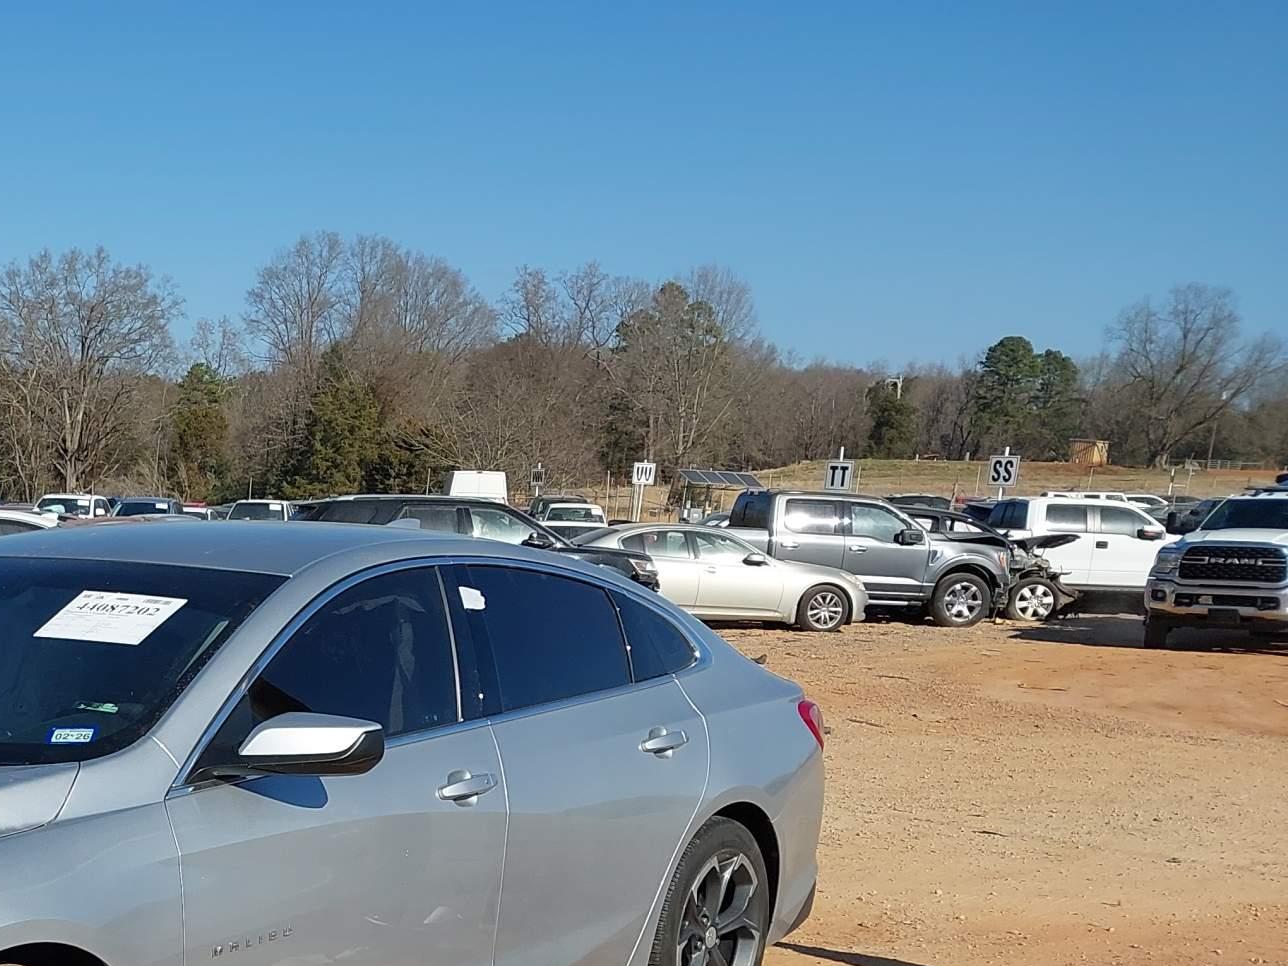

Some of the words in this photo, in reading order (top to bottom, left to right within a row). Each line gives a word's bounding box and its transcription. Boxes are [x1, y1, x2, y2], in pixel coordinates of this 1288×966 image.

[829, 465, 849, 487] TT
[991, 459, 1014, 483] SS
[1210, 557, 1256, 566] RAM
[76, 602, 161, 617] 44087202
